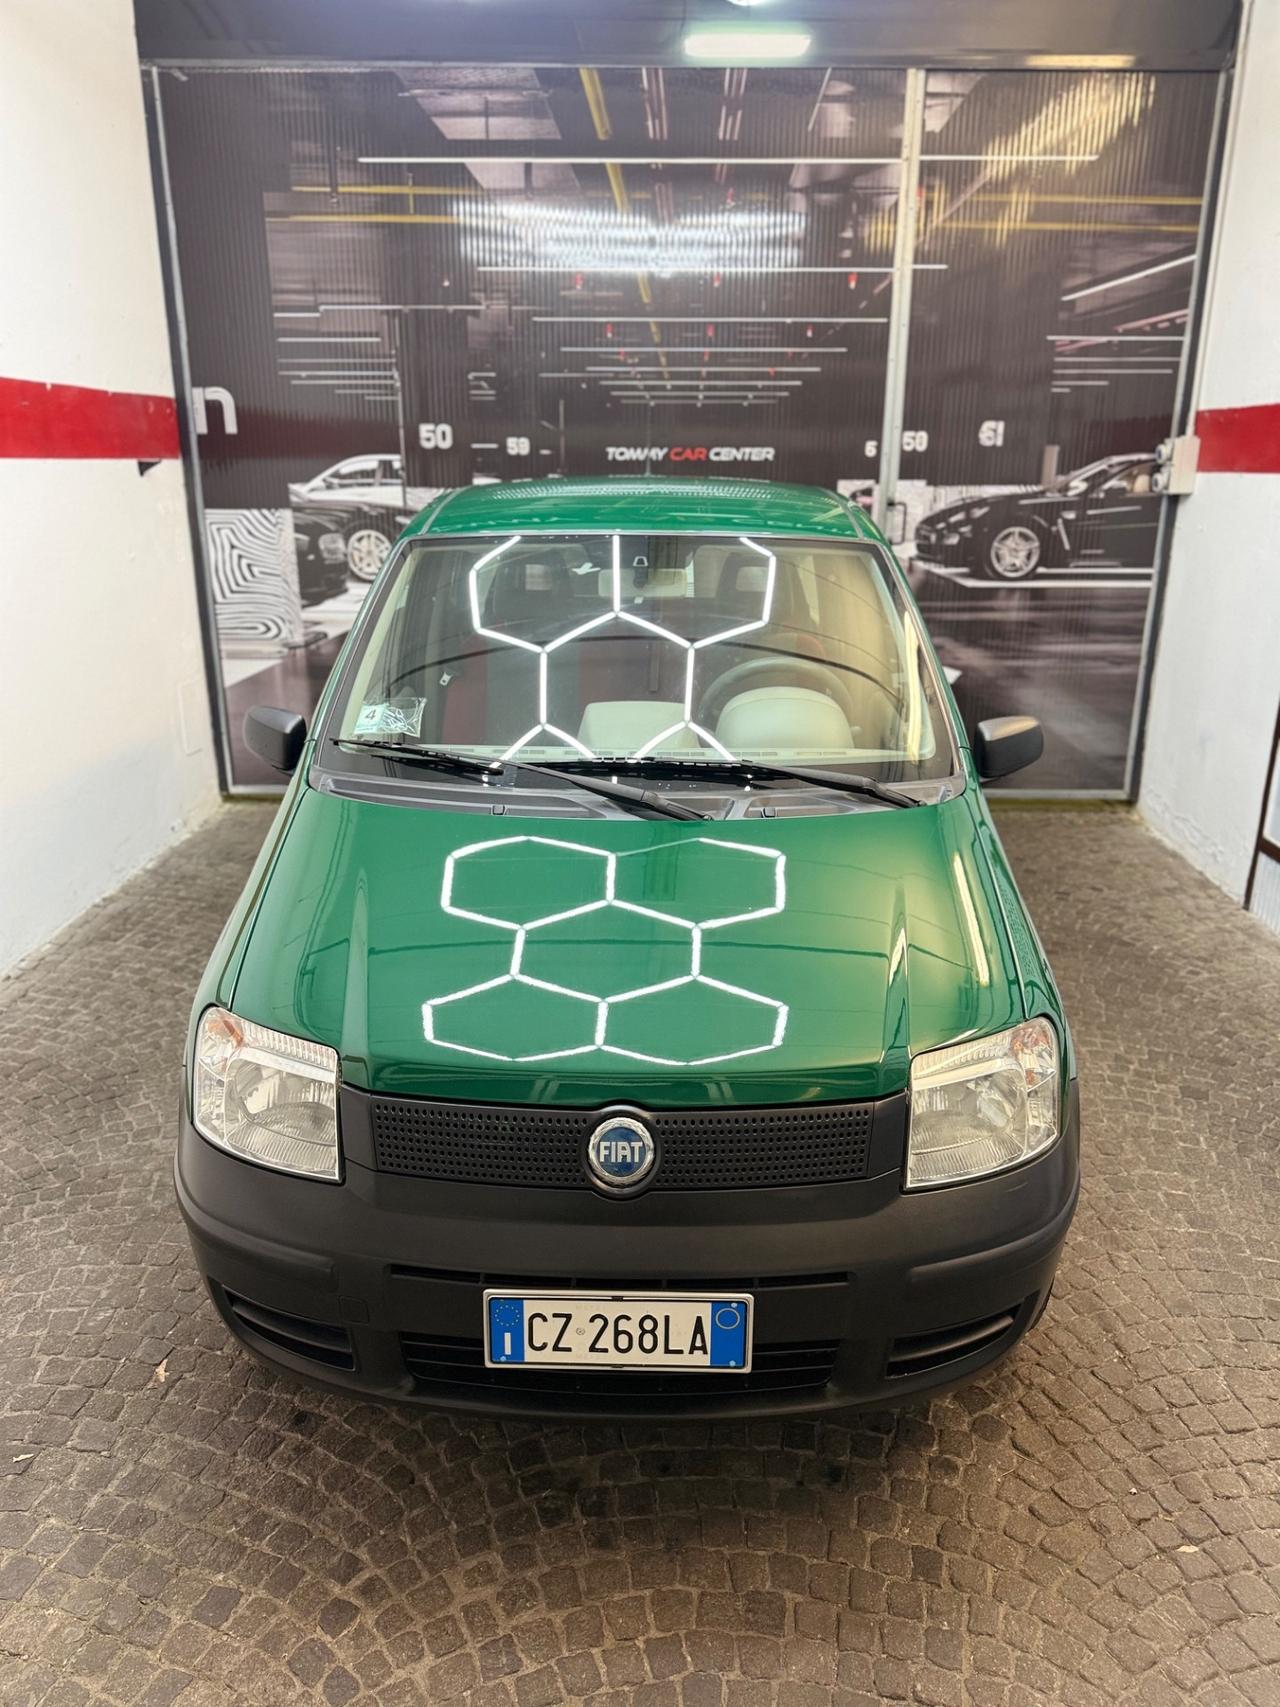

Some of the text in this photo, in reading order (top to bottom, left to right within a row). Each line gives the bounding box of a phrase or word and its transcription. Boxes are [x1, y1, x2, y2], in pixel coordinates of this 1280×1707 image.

[418, 422, 453, 450] 50
[669, 446, 708, 461] CAR
[708, 446, 776, 462] CENTER
[365, 709, 377, 720] 4
[599, 1141, 643, 1163] FIAT
[504, 1312, 709, 1355] I CZ 268LA
